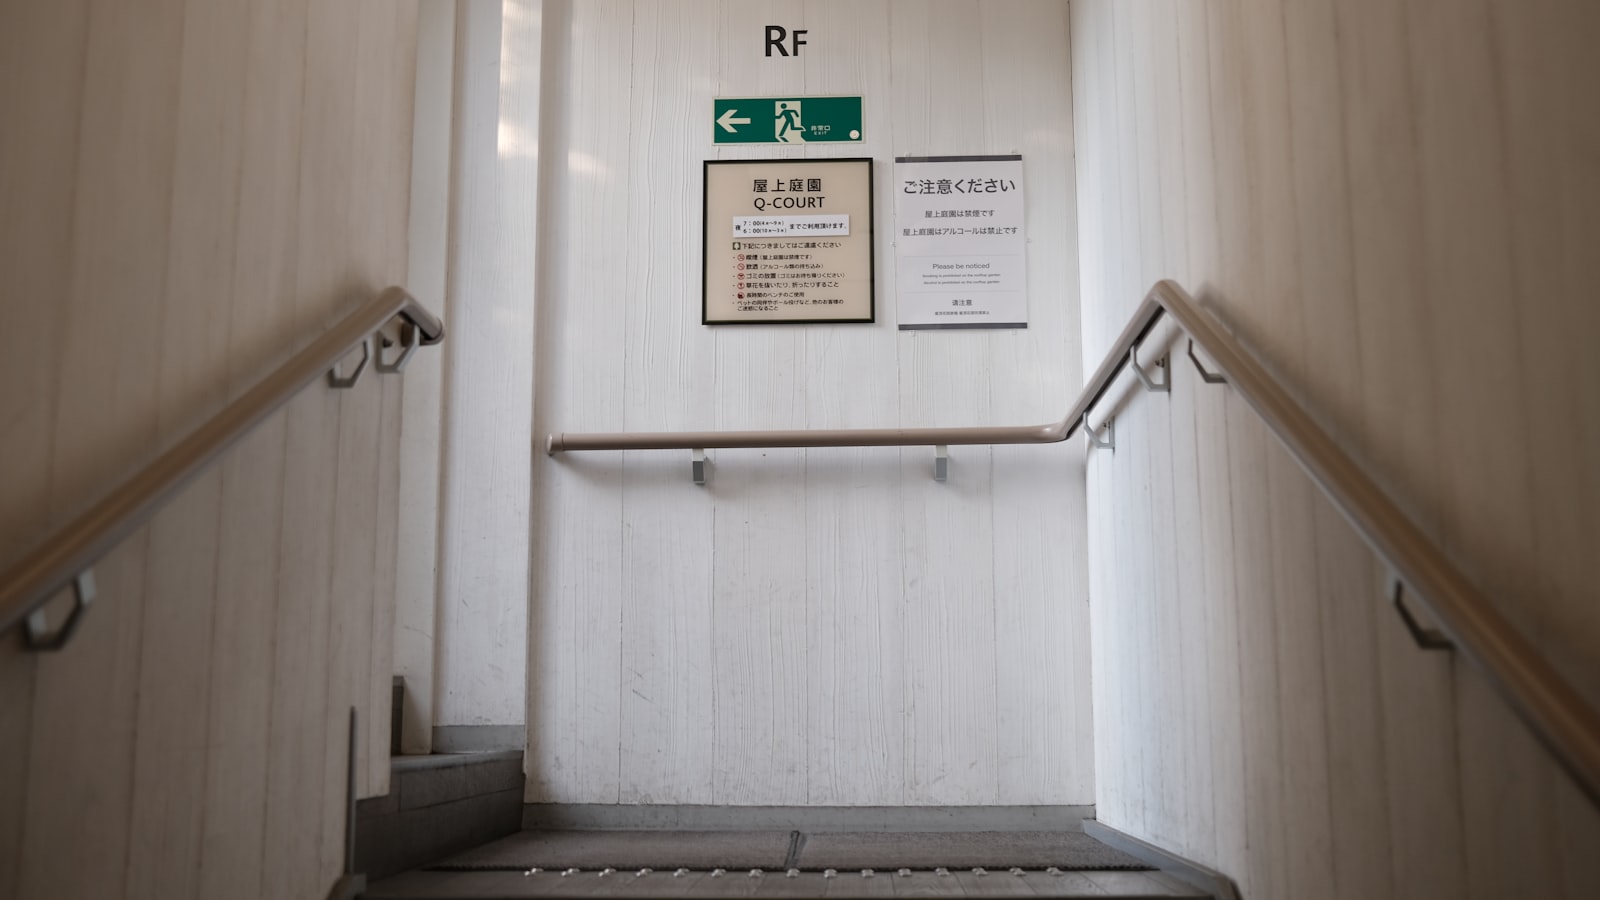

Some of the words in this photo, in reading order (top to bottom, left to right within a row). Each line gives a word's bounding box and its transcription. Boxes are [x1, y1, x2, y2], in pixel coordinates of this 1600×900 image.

[765, 25, 808, 57] RF
[753, 178, 821, 193] 屋上庭園
[903, 178, 1016, 195] ご注意ください
[753, 196, 825, 211] Q-COURT
[925, 209, 995, 219] 屋上庭園は禁煙です
[902, 226, 1018, 237] 屋上庭園はアルコールは禁止です
